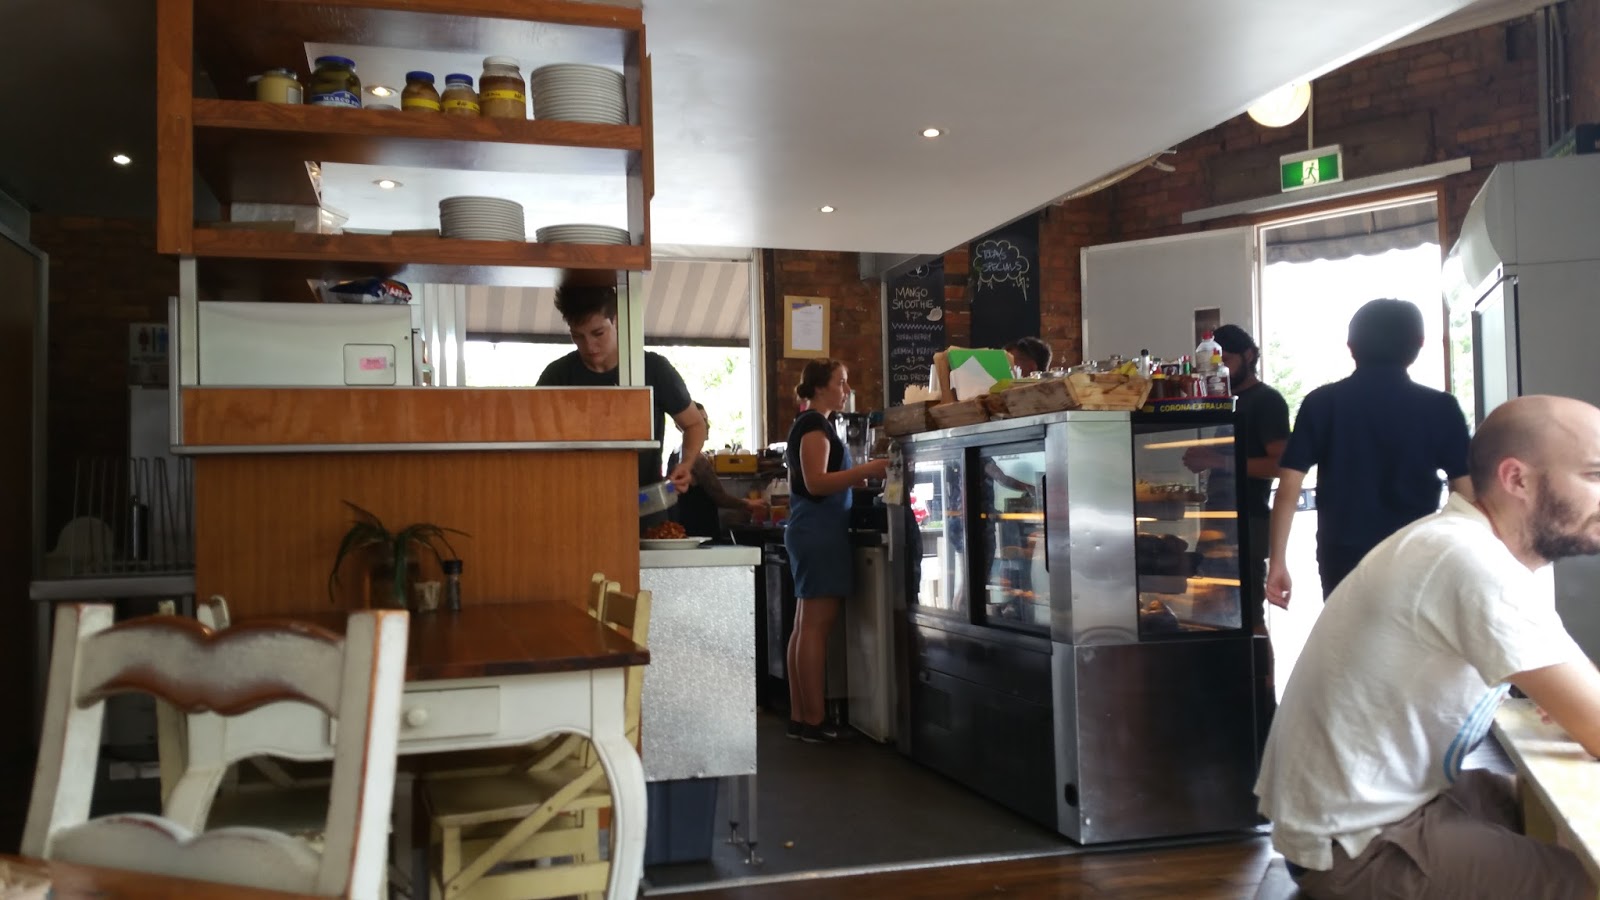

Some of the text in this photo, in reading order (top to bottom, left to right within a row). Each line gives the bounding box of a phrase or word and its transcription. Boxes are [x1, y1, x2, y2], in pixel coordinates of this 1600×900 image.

[323, 96, 350, 104] MARCO
[895, 286, 929, 301] MANGO
[891, 299, 934, 310] SMOOTHIE
[1160, 403, 1191, 413] CORONA
[1193, 402, 1215, 411] EXTRA
